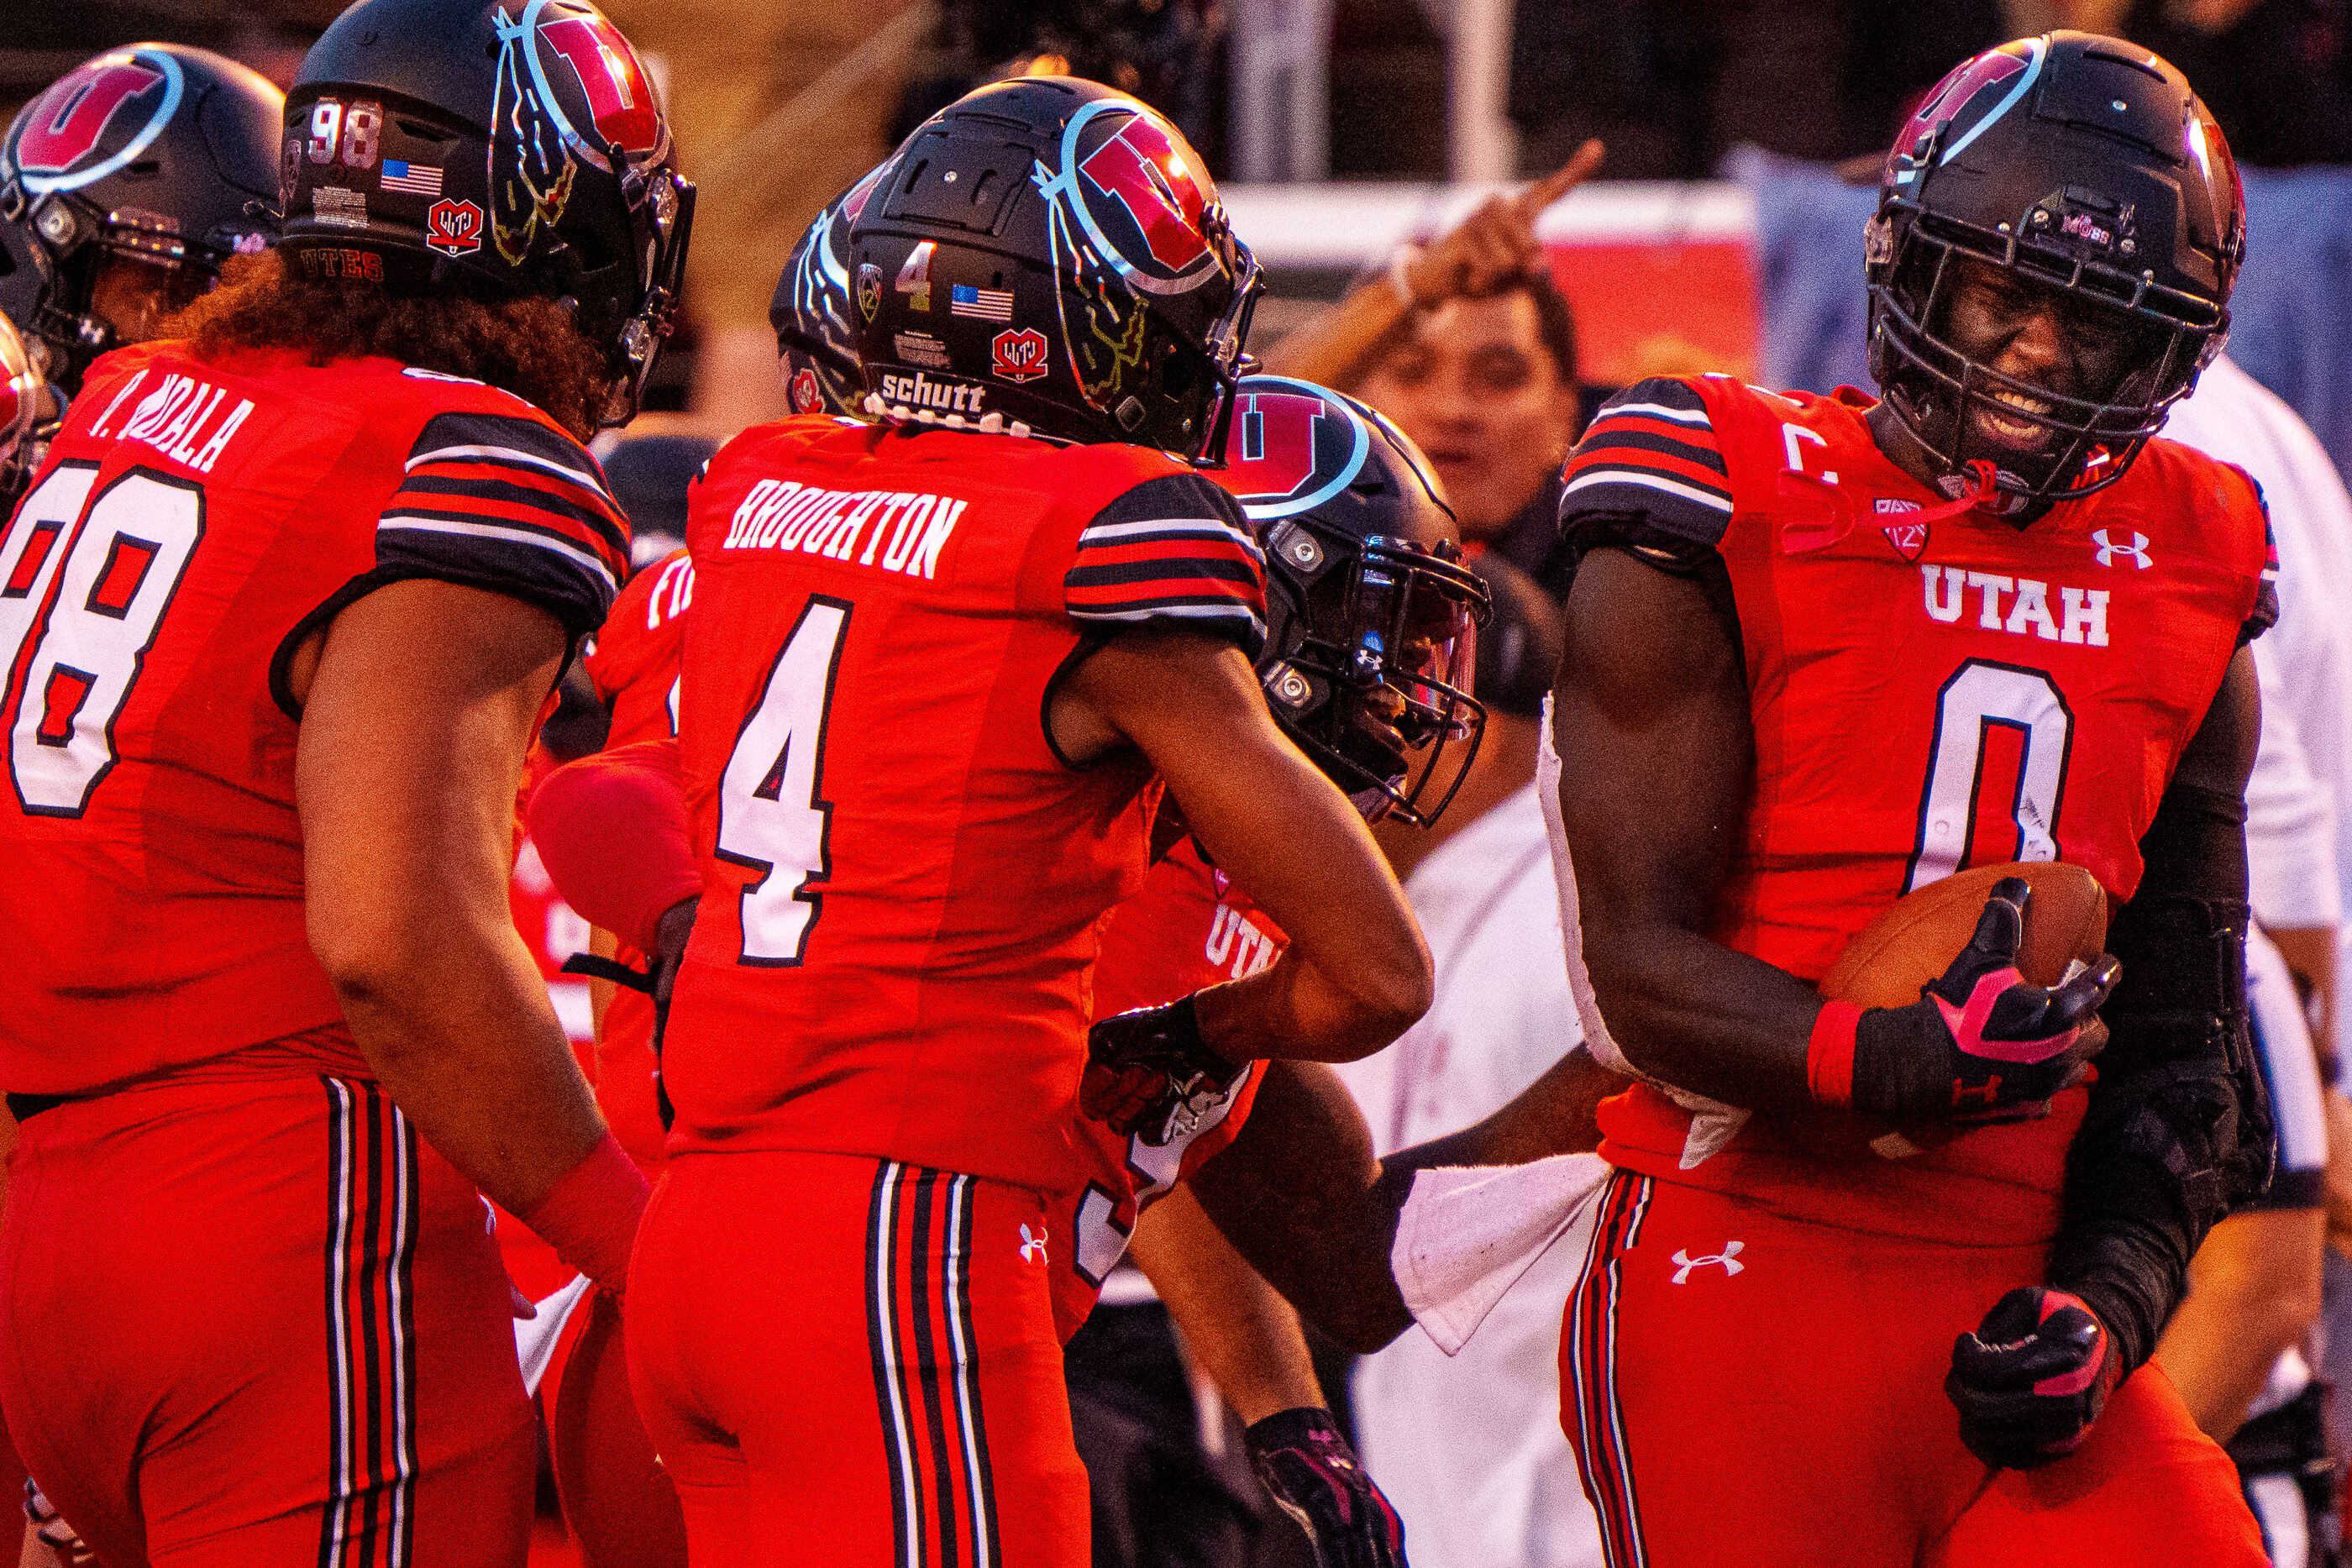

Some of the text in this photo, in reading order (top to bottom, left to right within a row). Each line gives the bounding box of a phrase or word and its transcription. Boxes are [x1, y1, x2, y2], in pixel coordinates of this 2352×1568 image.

[308, 97, 383, 169] 98
[894, 239, 937, 313] 4
[882, 372, 986, 413] schutt
[1205, 392, 1326, 499] U
[723, 478, 969, 580] BROUGHTON
[0, 457, 207, 820] 98
[1920, 564, 2111, 648] UTAH
[714, 592, 854, 967] 4
[1898, 656, 2075, 897] 0
[1205, 904, 1283, 979] UTA
